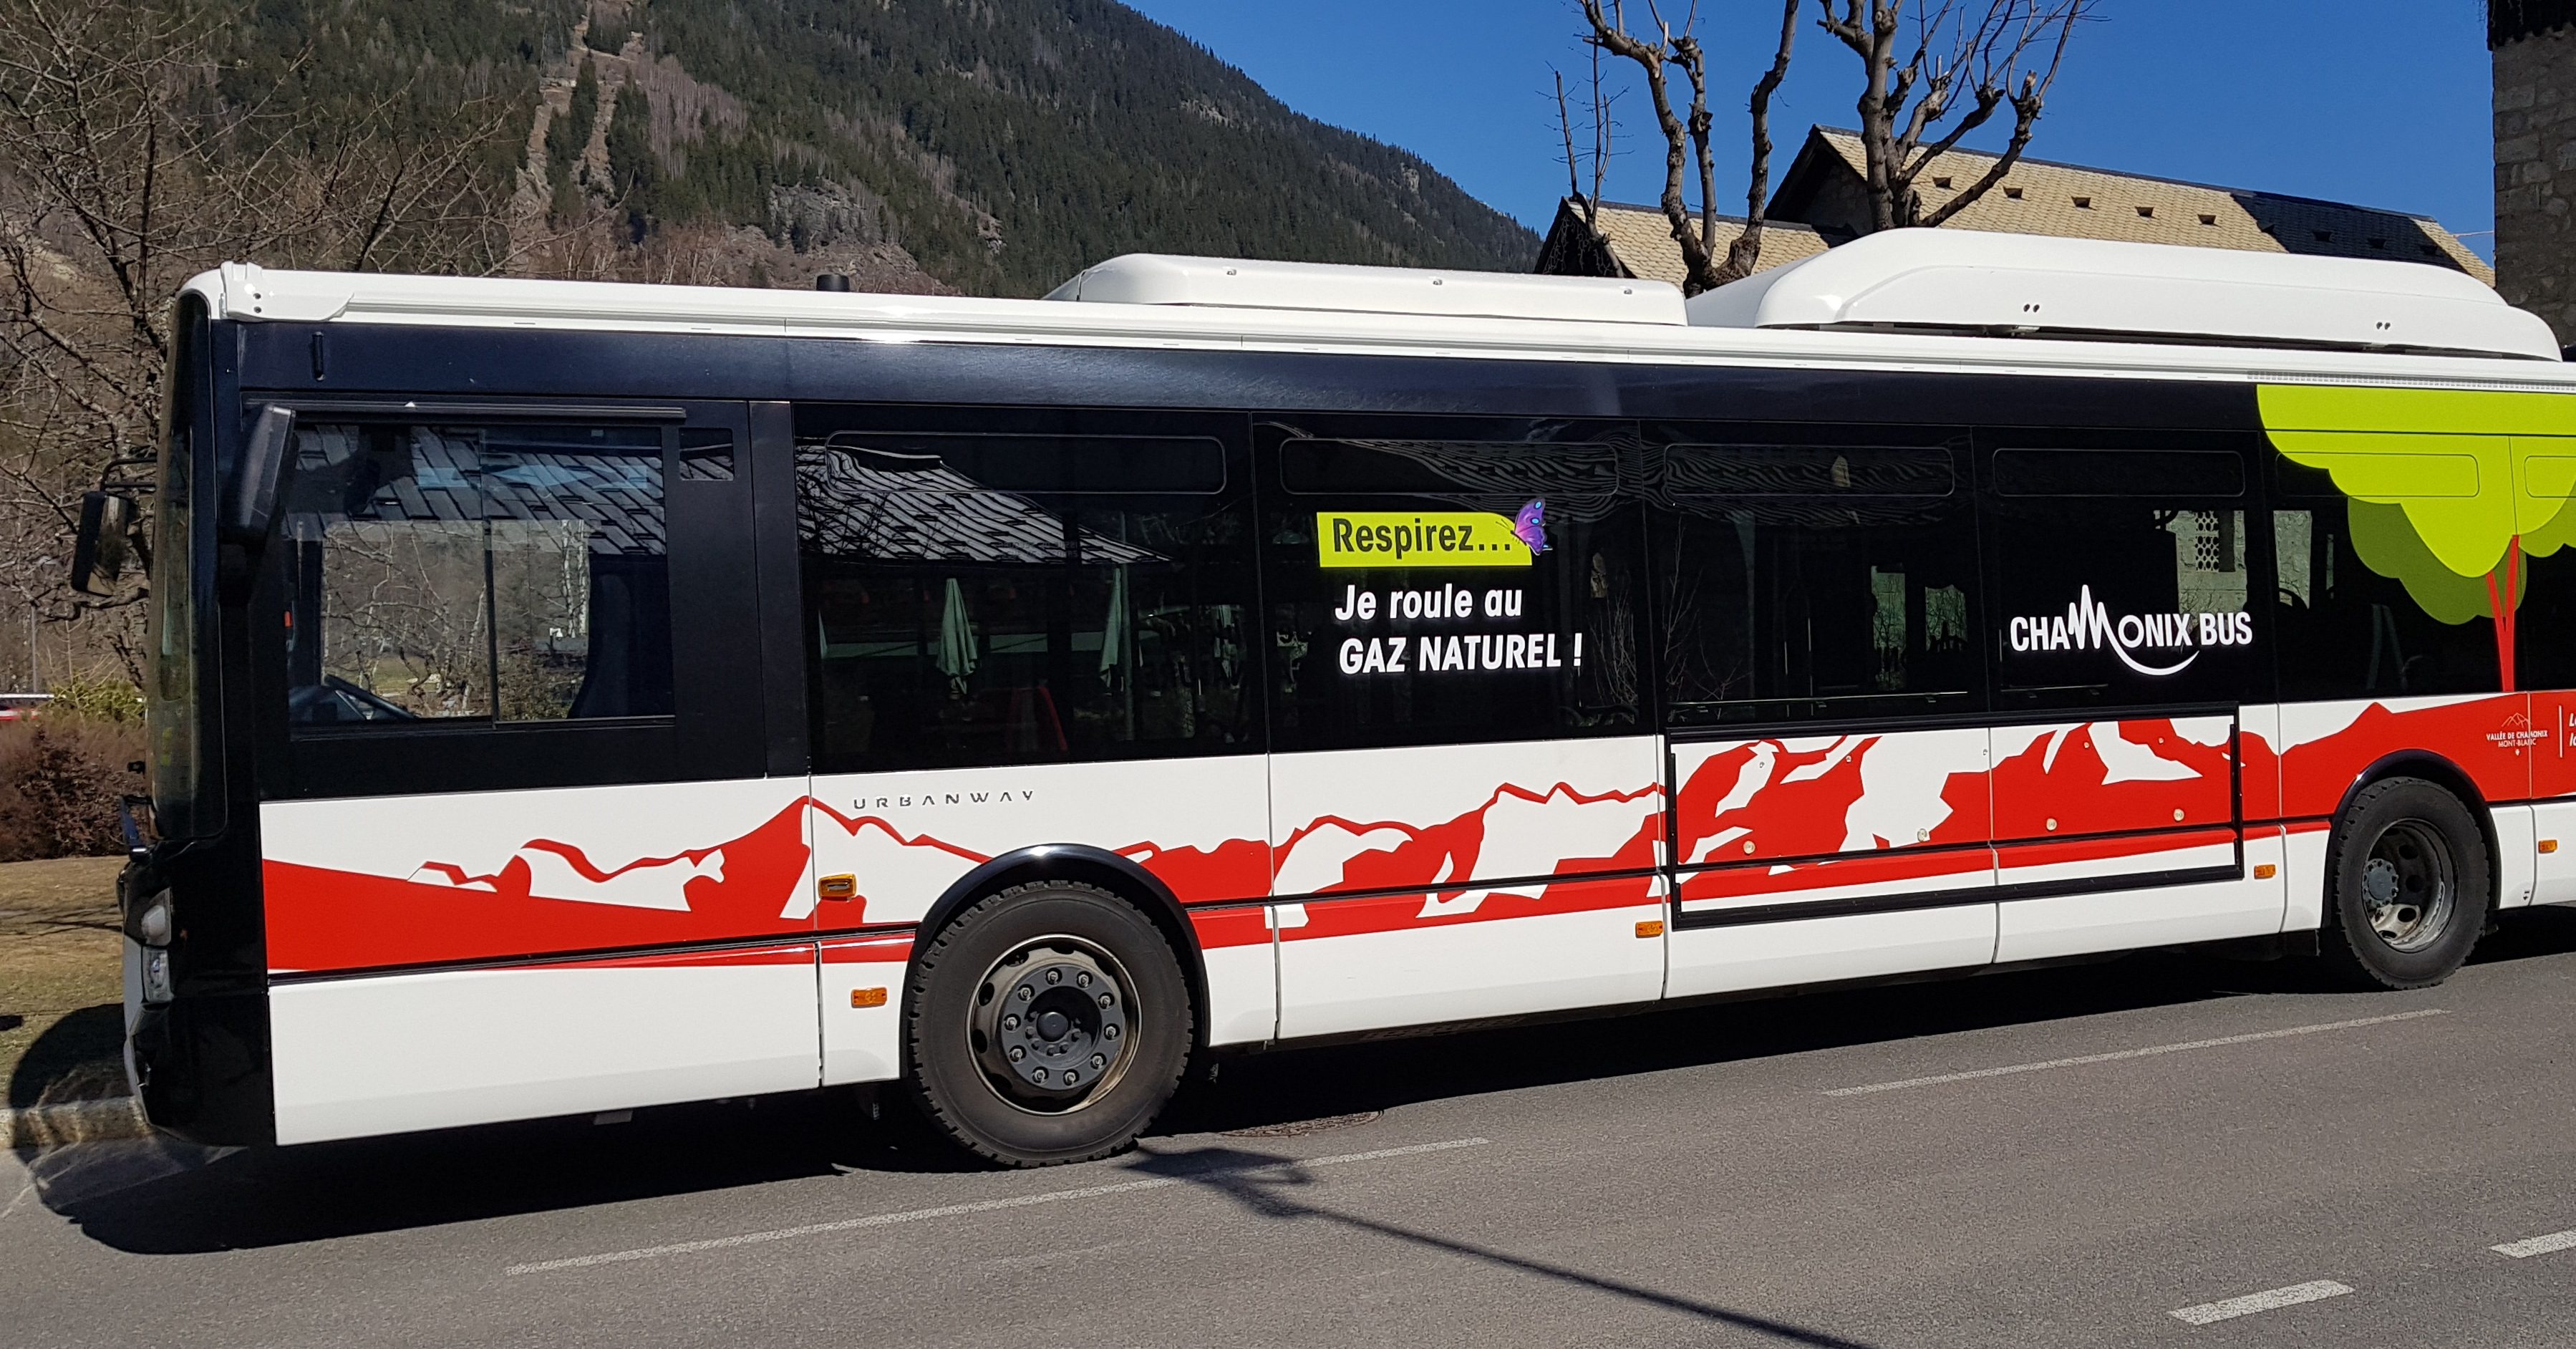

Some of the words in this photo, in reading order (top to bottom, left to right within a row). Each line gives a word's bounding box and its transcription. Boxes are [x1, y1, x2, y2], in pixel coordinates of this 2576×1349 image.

[1332, 517, 1511, 559] Respirez...
[1335, 584, 1377, 621] Je
[1390, 583, 1473, 619] roule
[1484, 589, 1523, 618] au
[2010, 584, 2200, 676] CHAMONIX
[2199, 611, 2252, 646] BUS
[1339, 637, 1408, 674] GAZ
[1418, 633, 1561, 672] NATUREL
[1573, 633, 1583, 667] !
[2486, 731, 2507, 741] VALLÉE
[2498, 738, 2537, 748] MONT-BLANC
[853, 790, 1033, 810] URBANWAY
